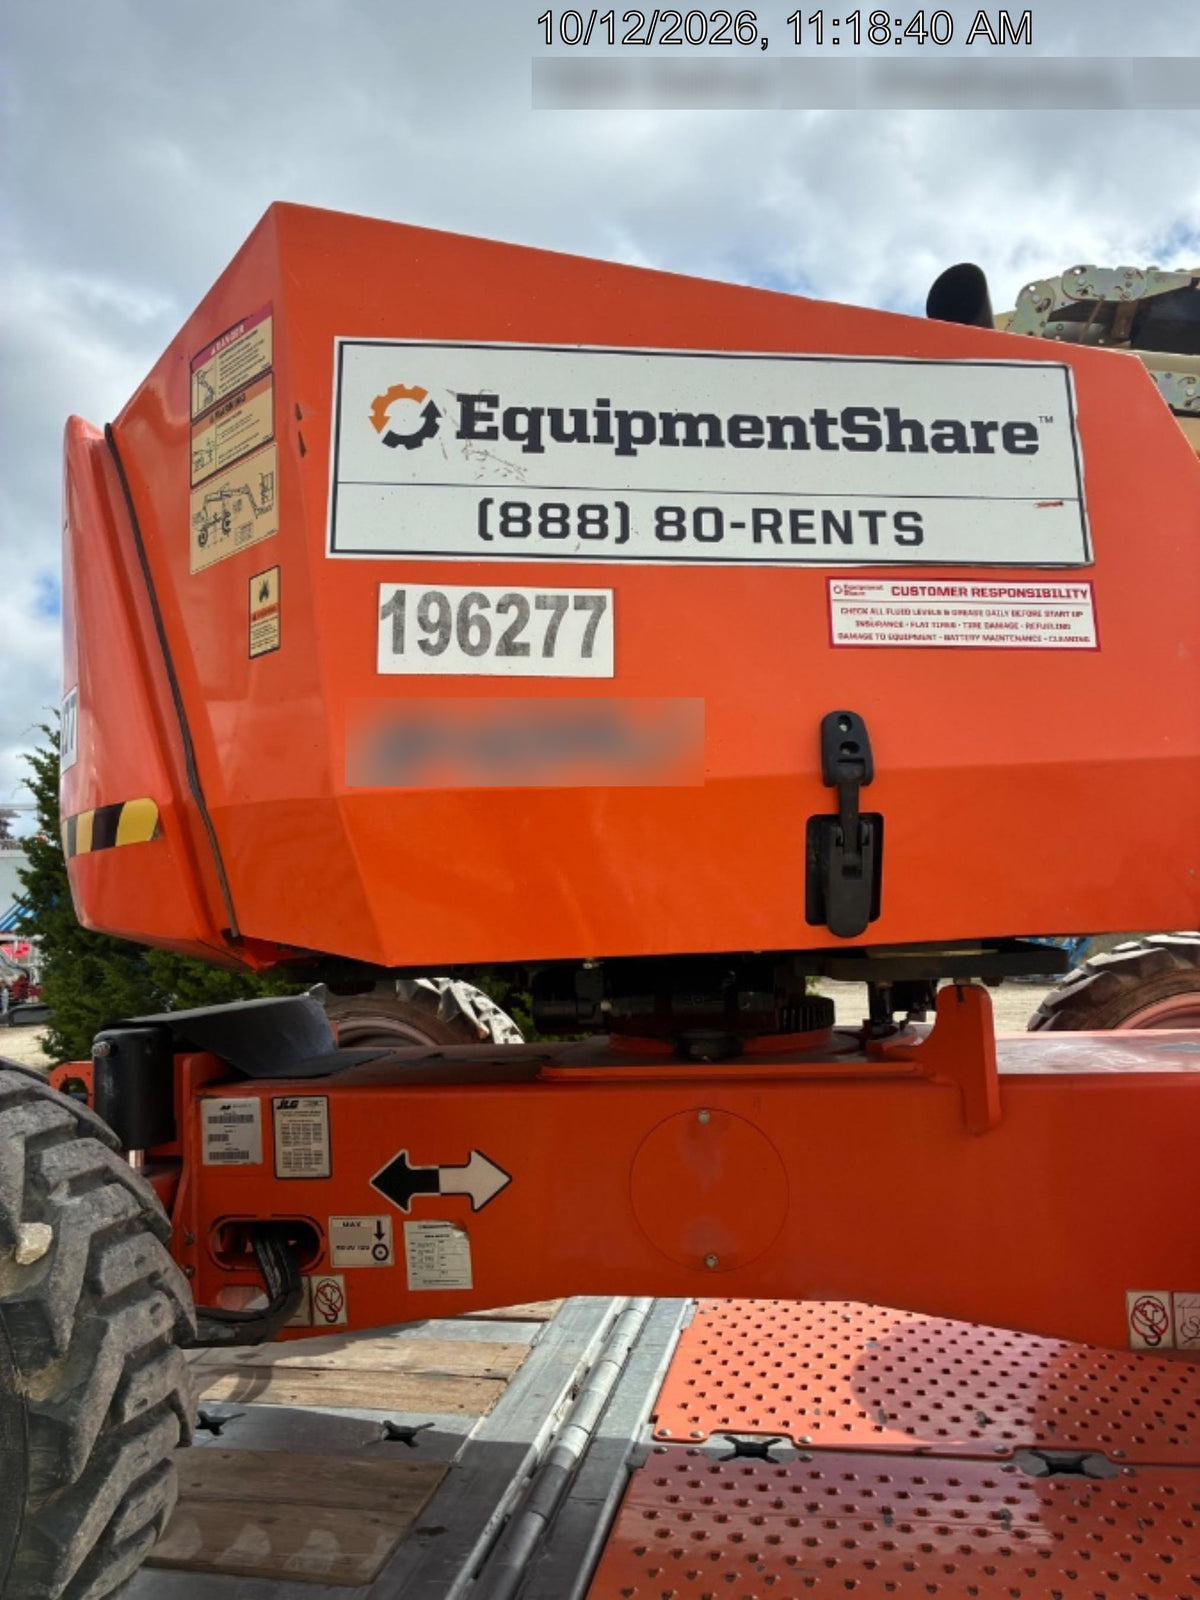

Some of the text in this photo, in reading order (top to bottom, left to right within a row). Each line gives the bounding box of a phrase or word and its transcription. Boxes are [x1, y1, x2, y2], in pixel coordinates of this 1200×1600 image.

[456, 393, 1039, 457] EquipmentShare
[478, 497, 924, 546] (888) 80-RENTS
[891, 586, 1088, 599] CUSTOMER RESPONSIBILITY
[380, 589, 607, 658] 196277
[876, 633, 886, 641] TO
[276, 1100, 299, 1110] JLG
